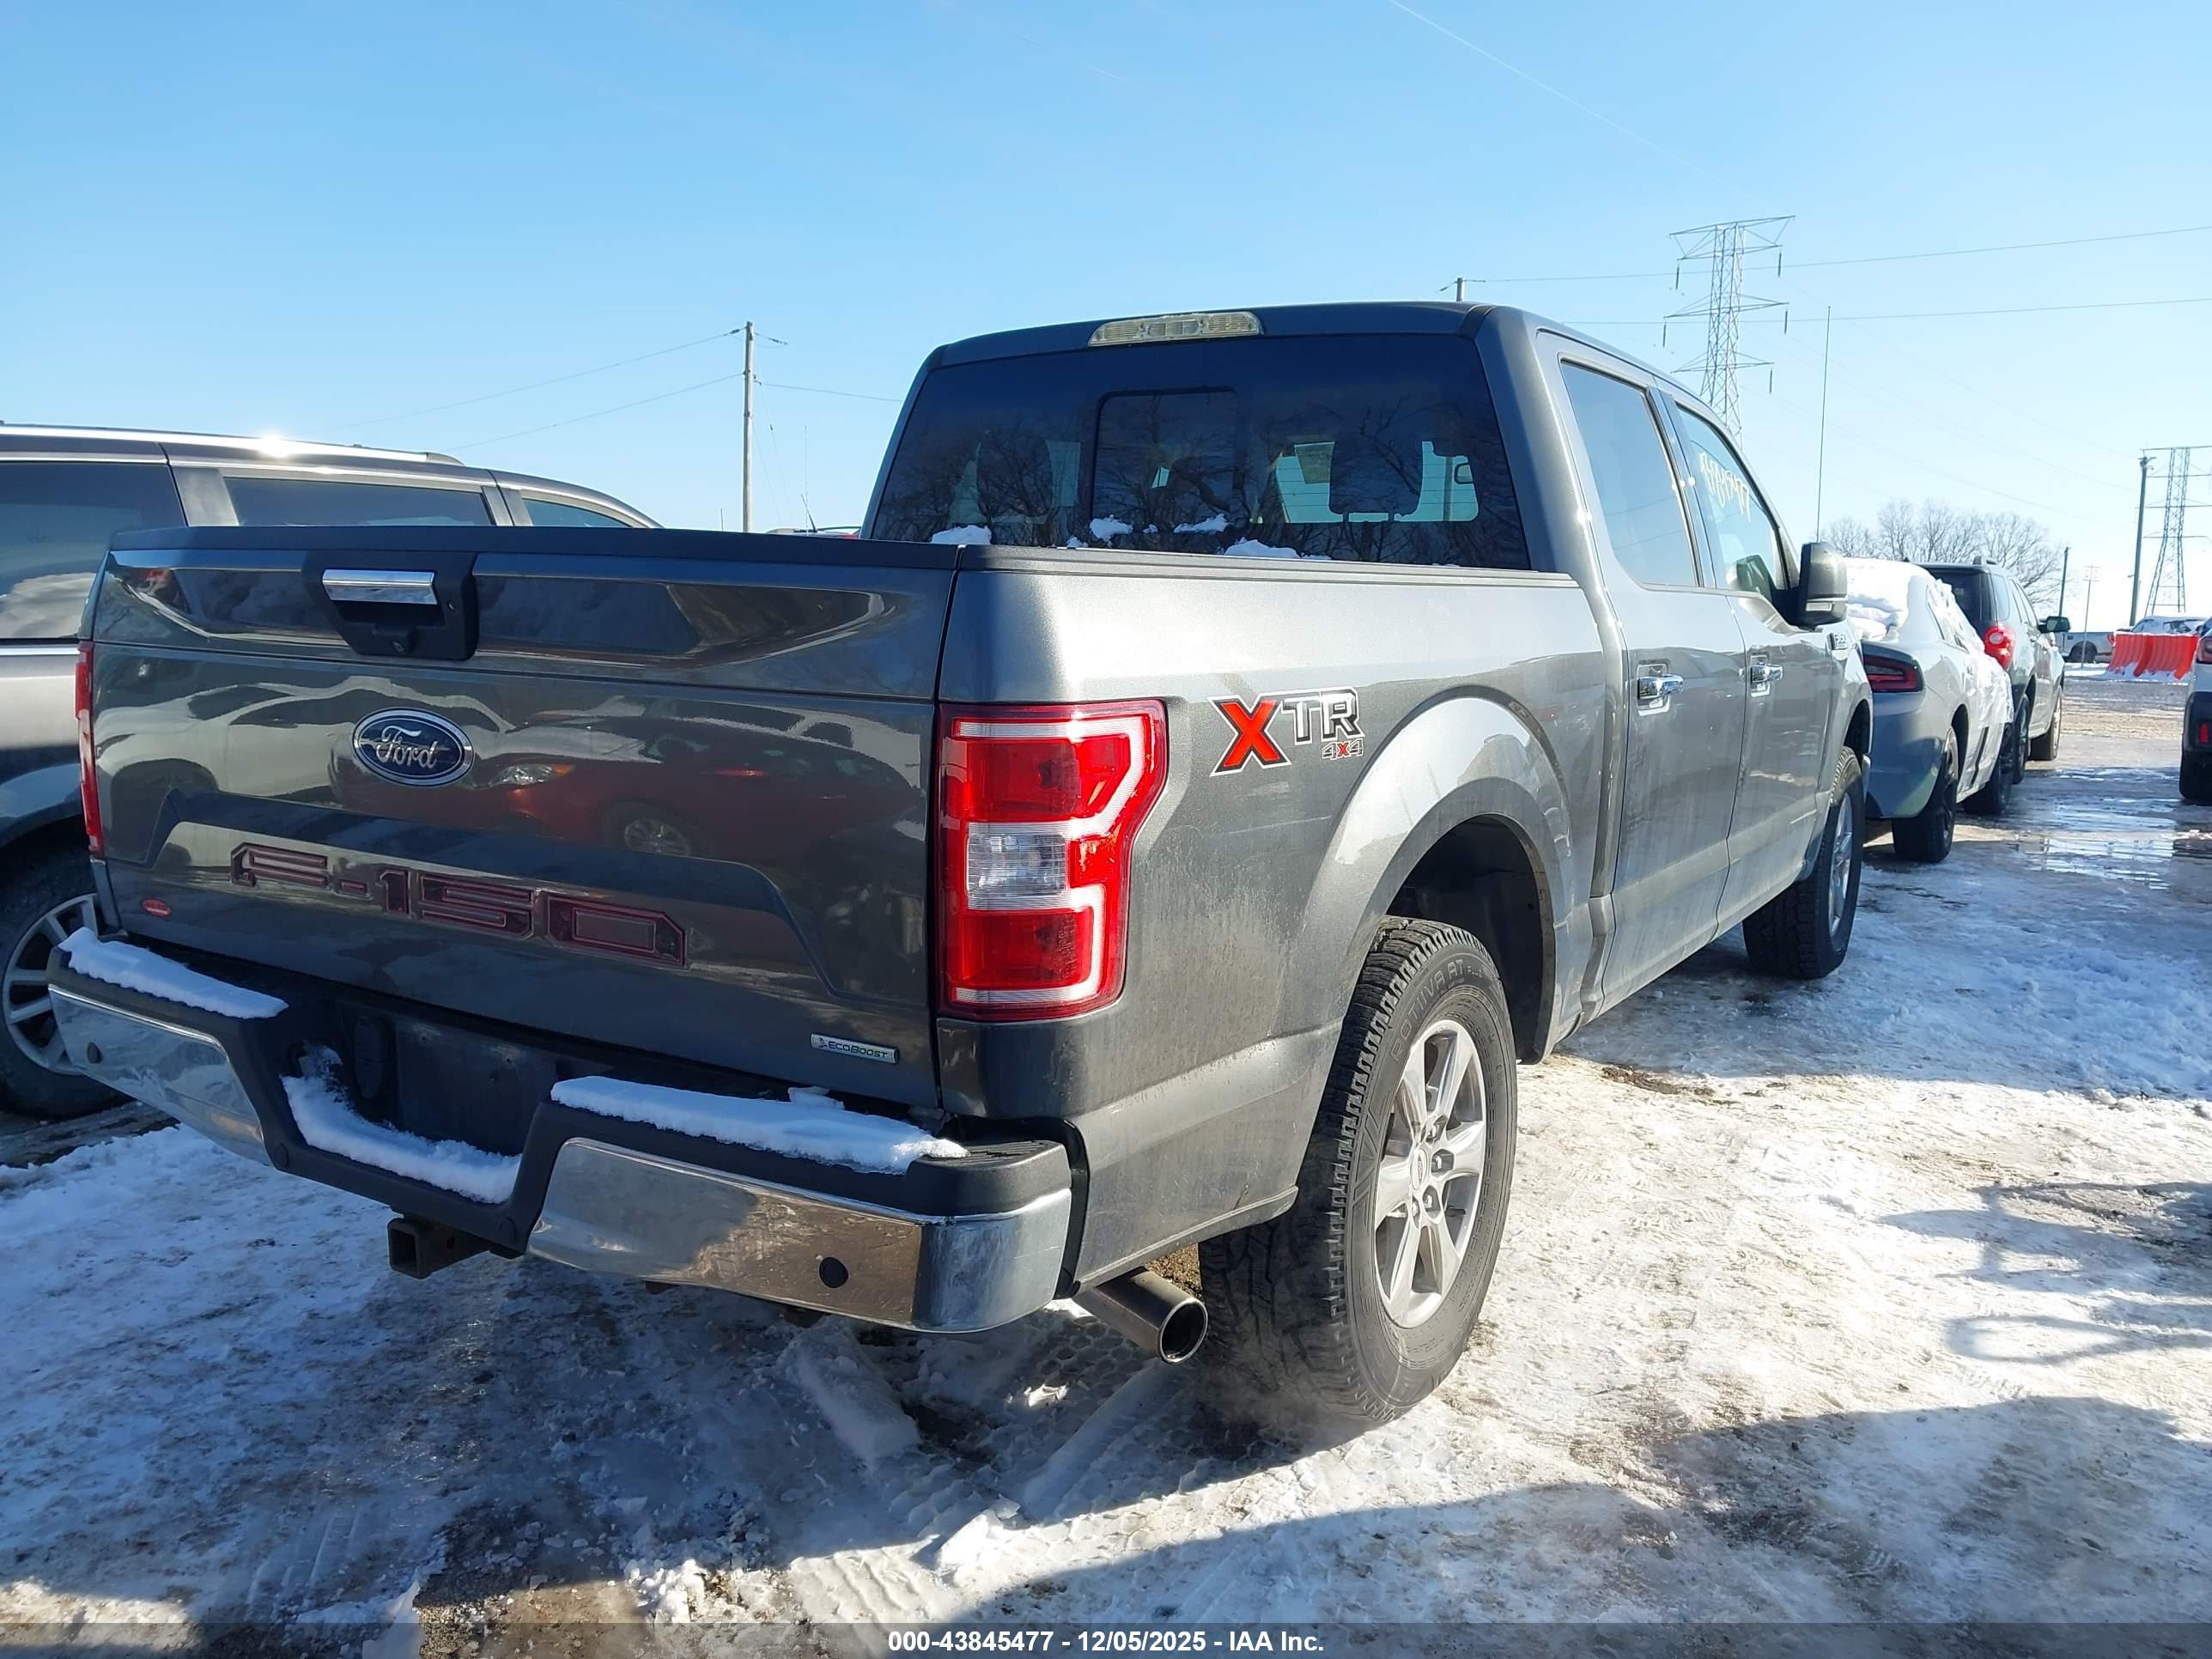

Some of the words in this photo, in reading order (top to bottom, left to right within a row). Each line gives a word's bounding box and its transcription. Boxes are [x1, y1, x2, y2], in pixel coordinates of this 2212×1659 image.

[376, 725, 439, 769] Ford
[1206, 686, 1365, 777] XTR
[230, 842, 686, 968] F-150
